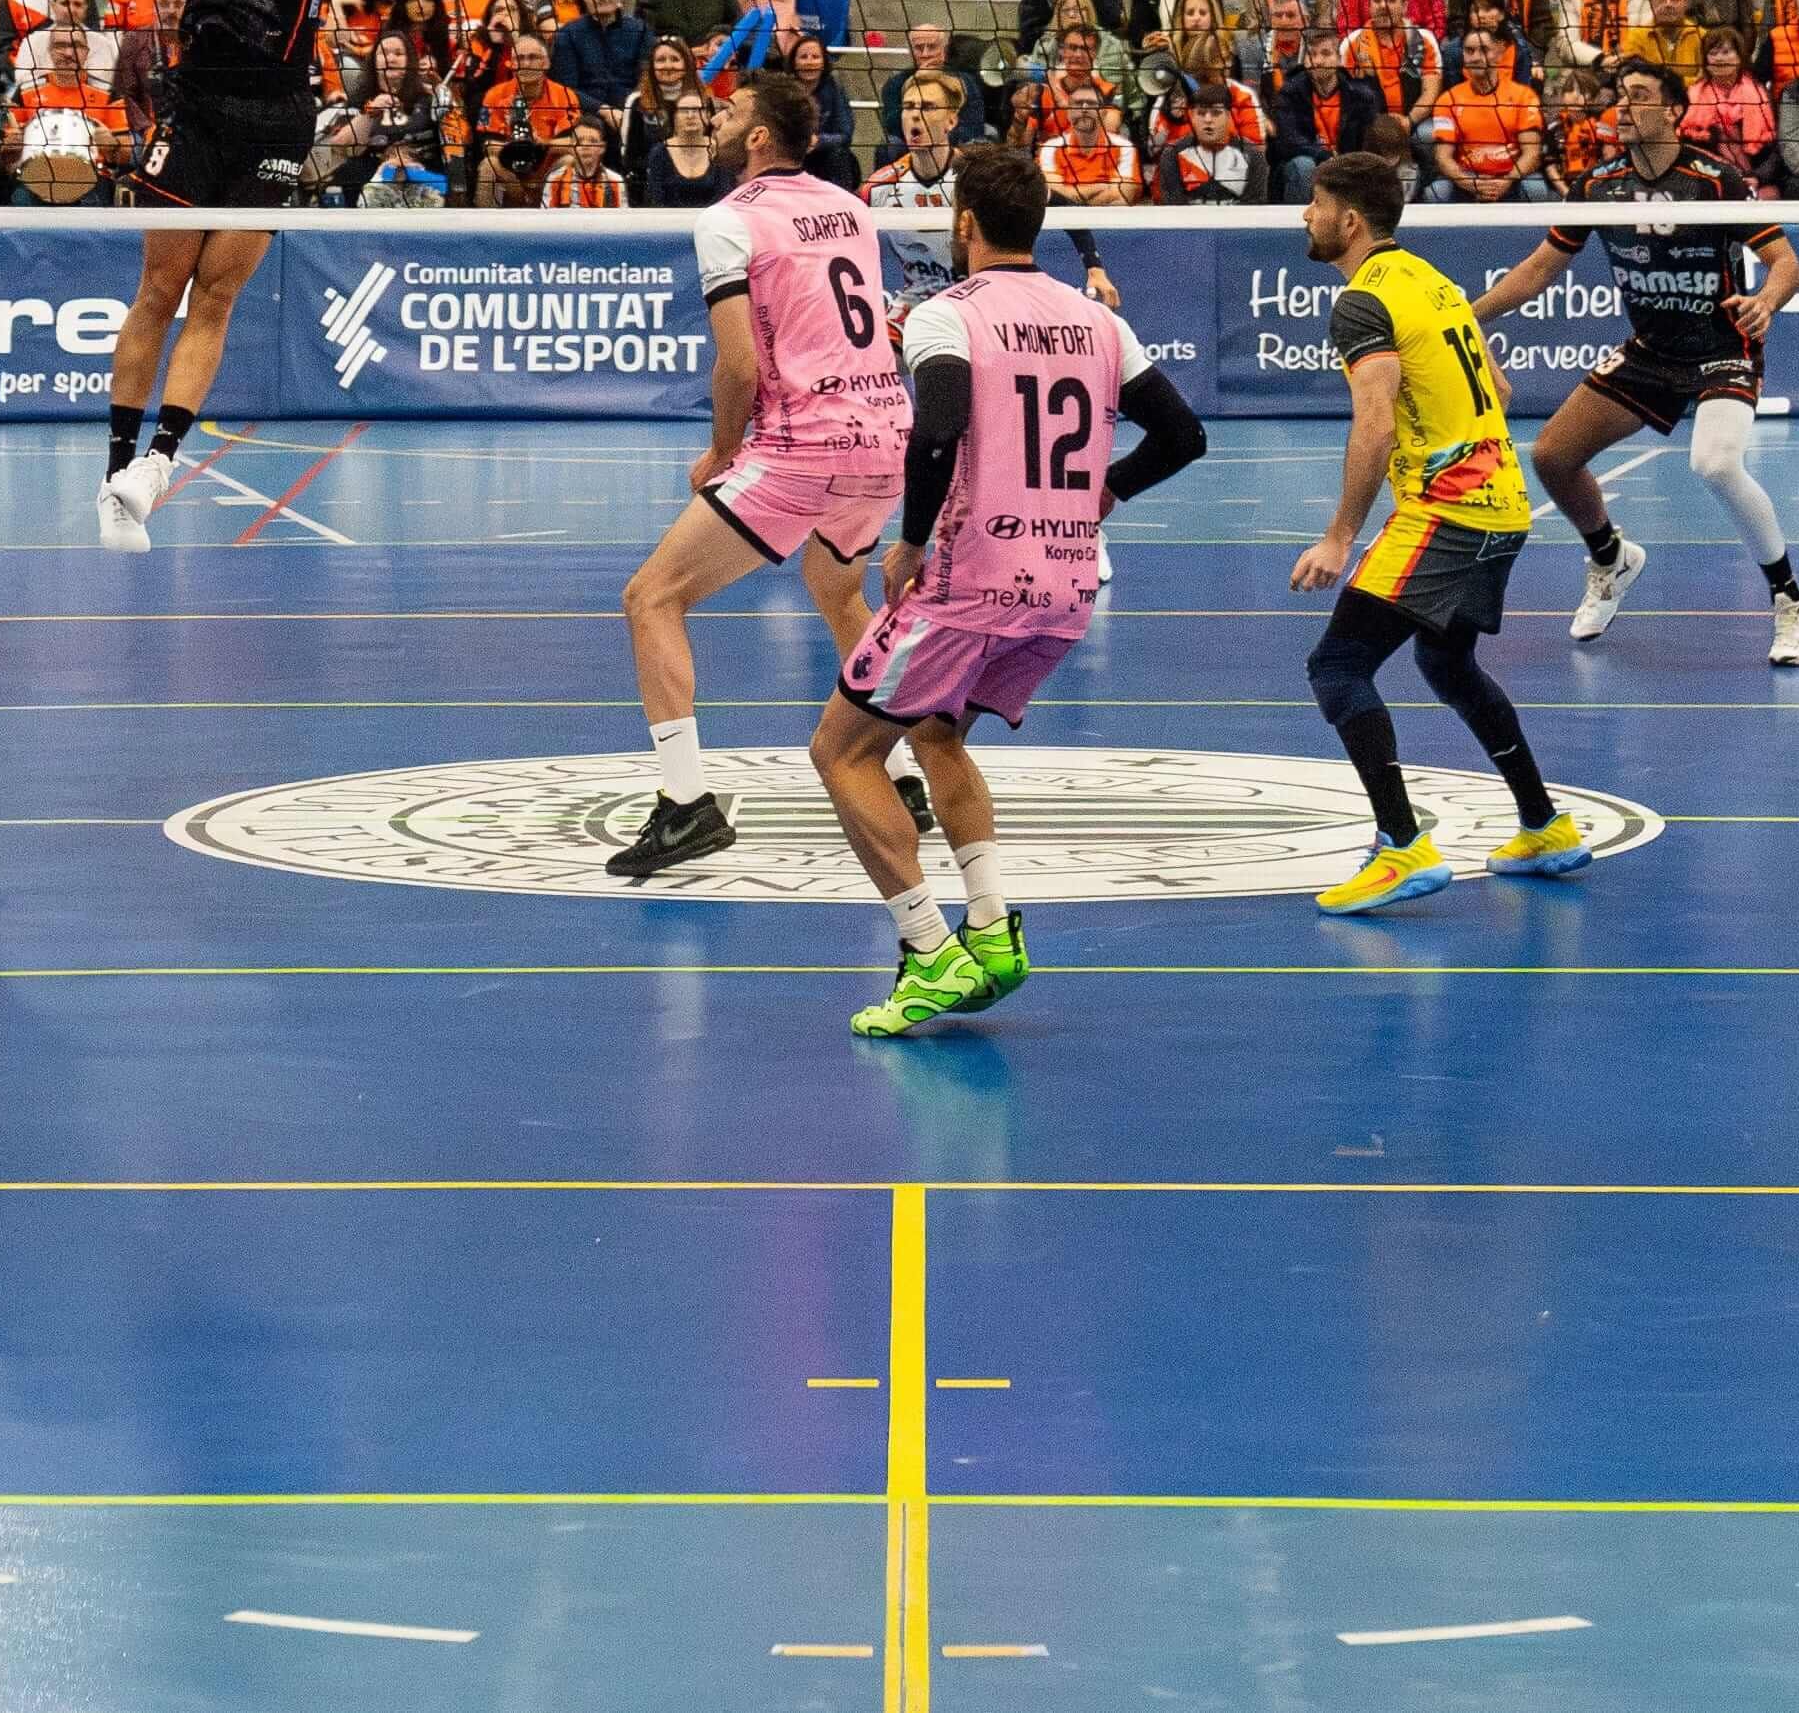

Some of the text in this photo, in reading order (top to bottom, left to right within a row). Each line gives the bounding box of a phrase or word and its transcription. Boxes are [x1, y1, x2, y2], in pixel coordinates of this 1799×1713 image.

[792, 210, 860, 243] SCARPIN
[404, 262, 673, 286] Comunitat Valenciana
[1613, 265, 1720, 296] PAMESA
[401, 292, 673, 329] COMUNITAT
[828, 256, 875, 350] 6
[420, 335, 479, 372] DE
[994, 322, 1095, 357] V.MONFORT
[1, 372, 47, 403] per
[1015, 374, 1092, 490] 12
[1045, 545, 1084, 563] Koryo
